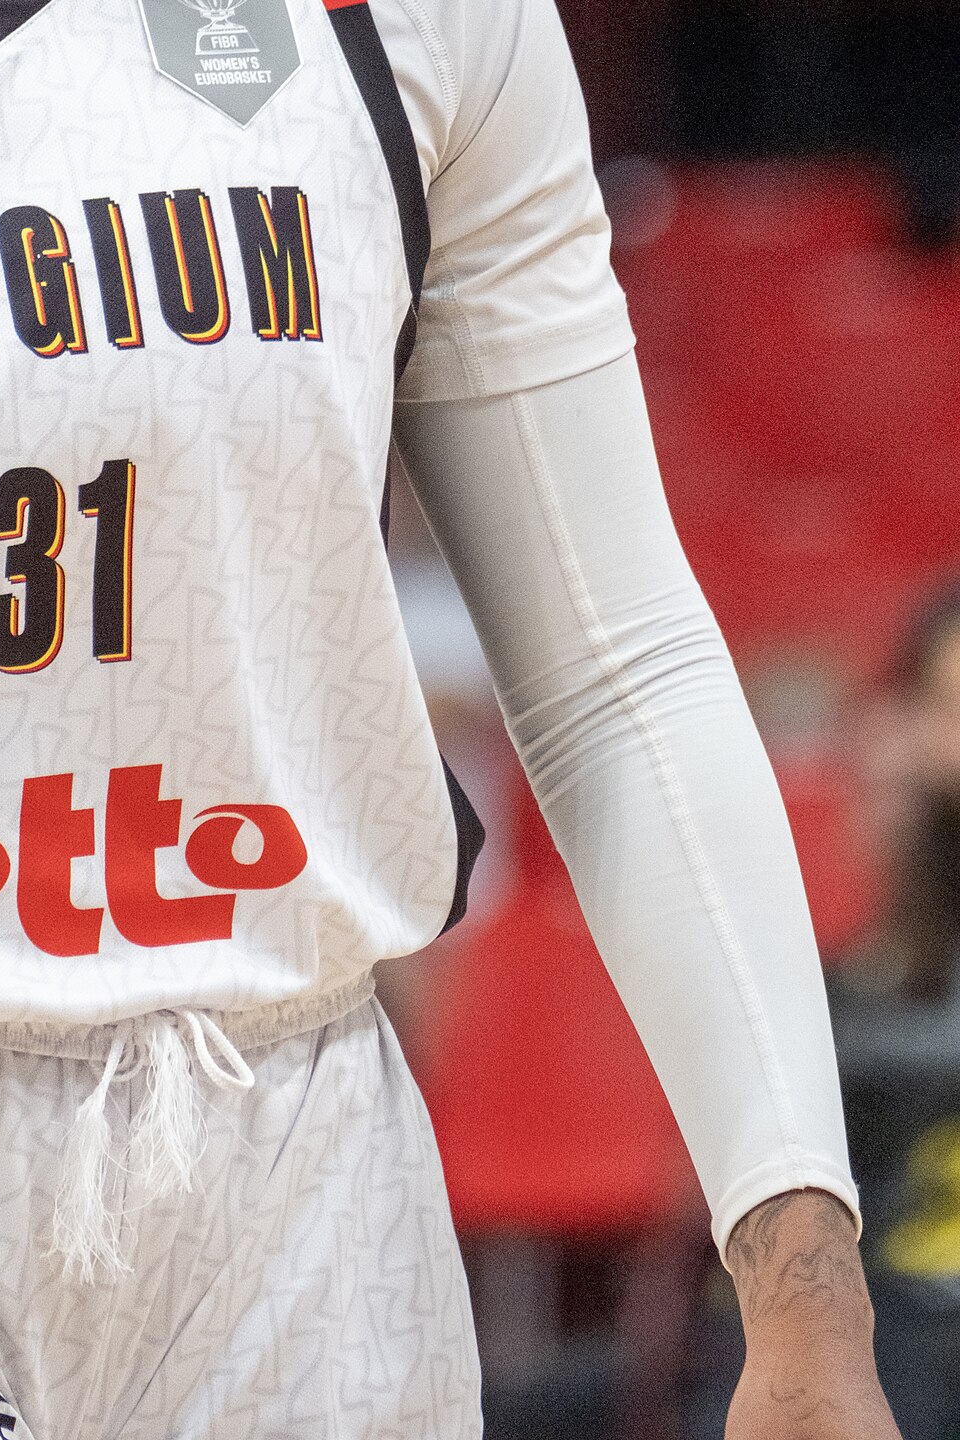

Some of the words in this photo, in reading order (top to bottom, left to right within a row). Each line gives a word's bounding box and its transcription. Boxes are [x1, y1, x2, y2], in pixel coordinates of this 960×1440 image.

[210, 34, 239, 49] FIBA
[200, 56, 260, 72] WOMEN'S
[194, 70, 272, 86] EUROBASKET
